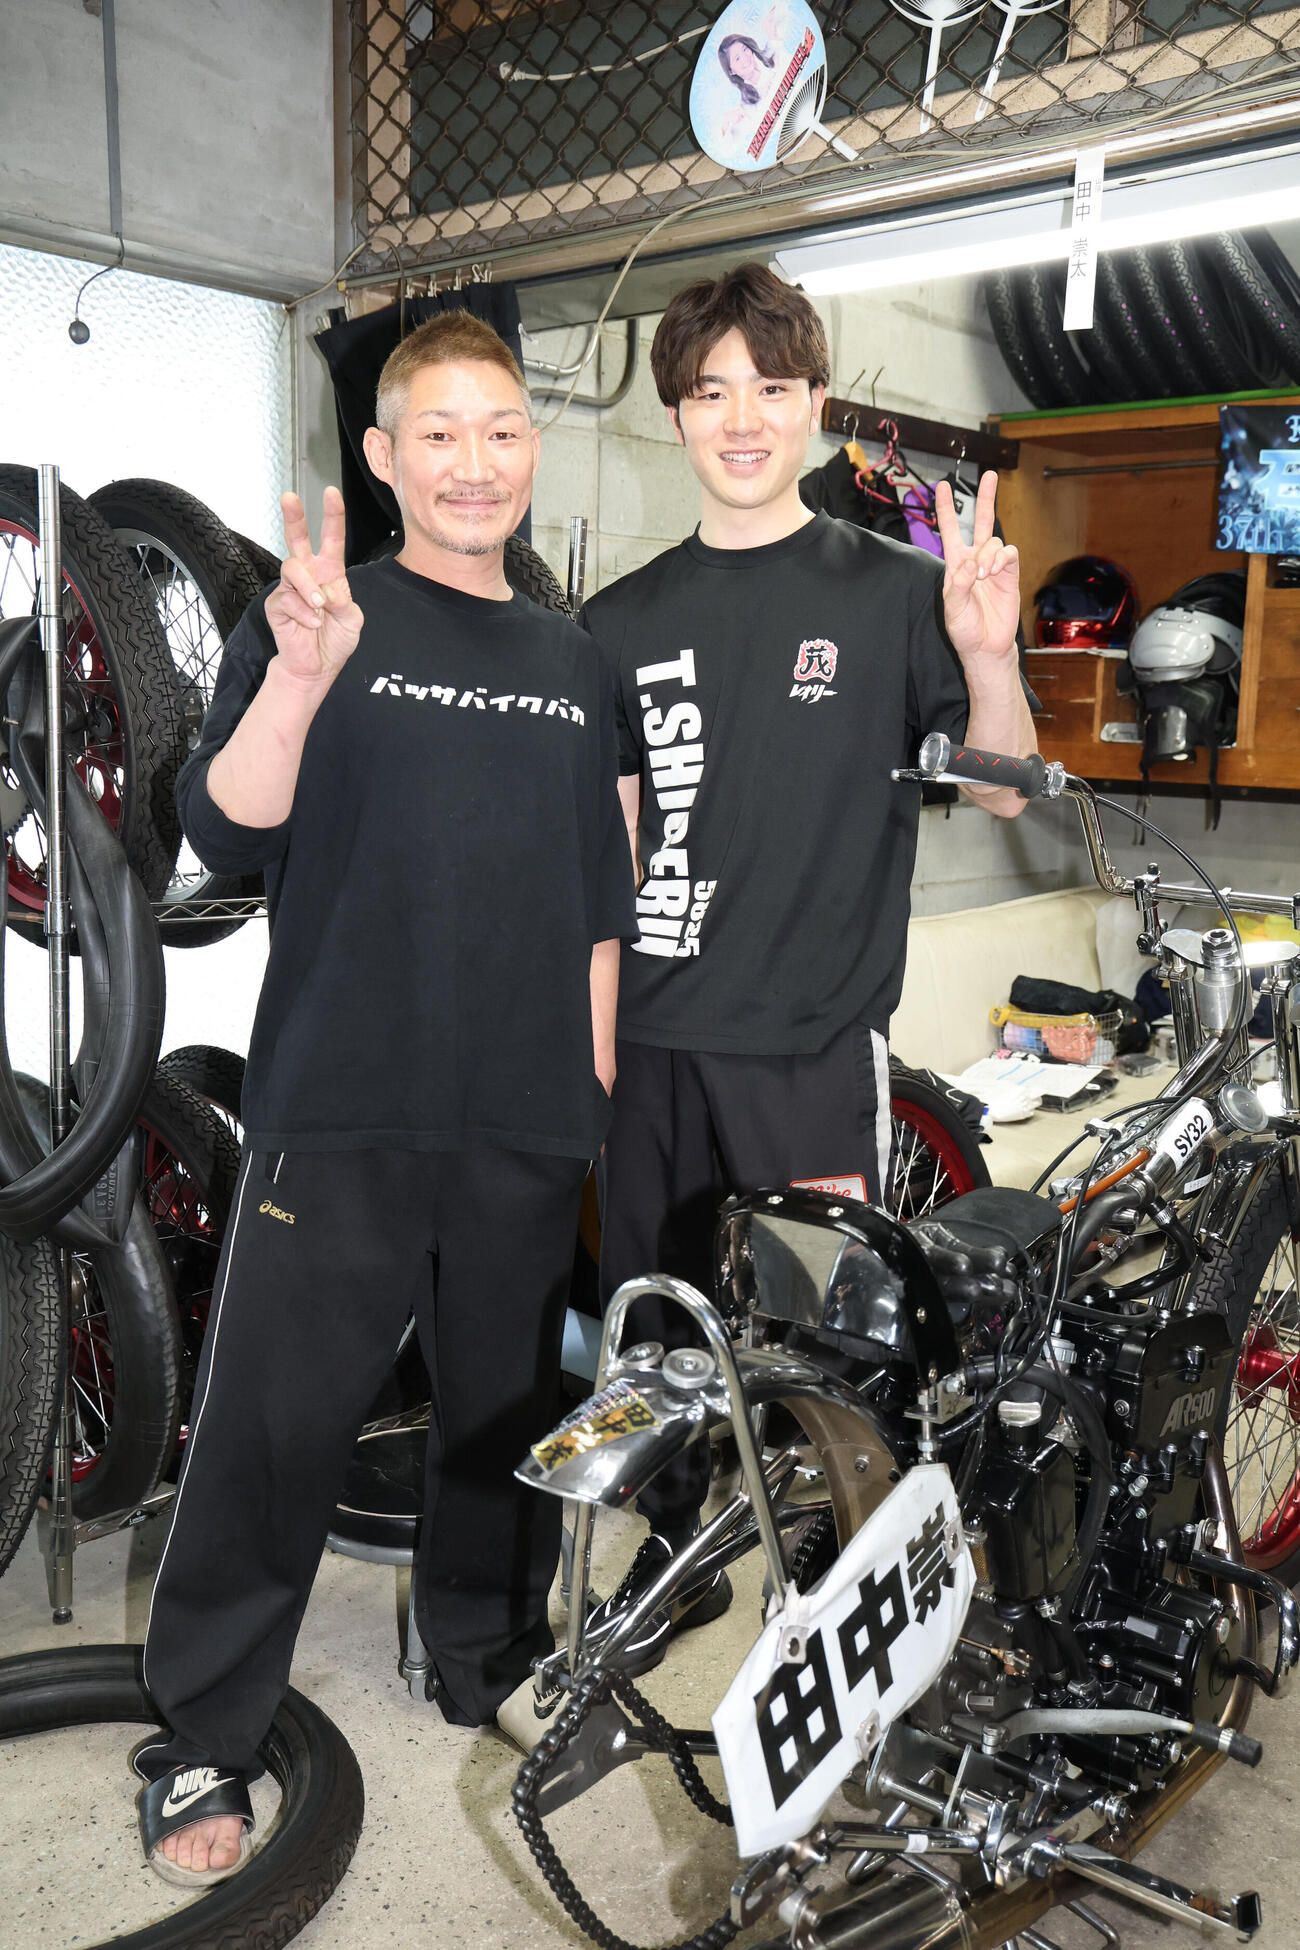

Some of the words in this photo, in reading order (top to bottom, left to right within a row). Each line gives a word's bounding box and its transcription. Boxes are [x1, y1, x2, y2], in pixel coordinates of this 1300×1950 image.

[1075, 181, 1092, 222] 田中
[1070, 238, 1088, 279] 崇太
[1174, 1114, 1208, 1158] SY32
[268, 1205, 296, 1225] asics
[170, 1766, 219, 1800] NIKE
